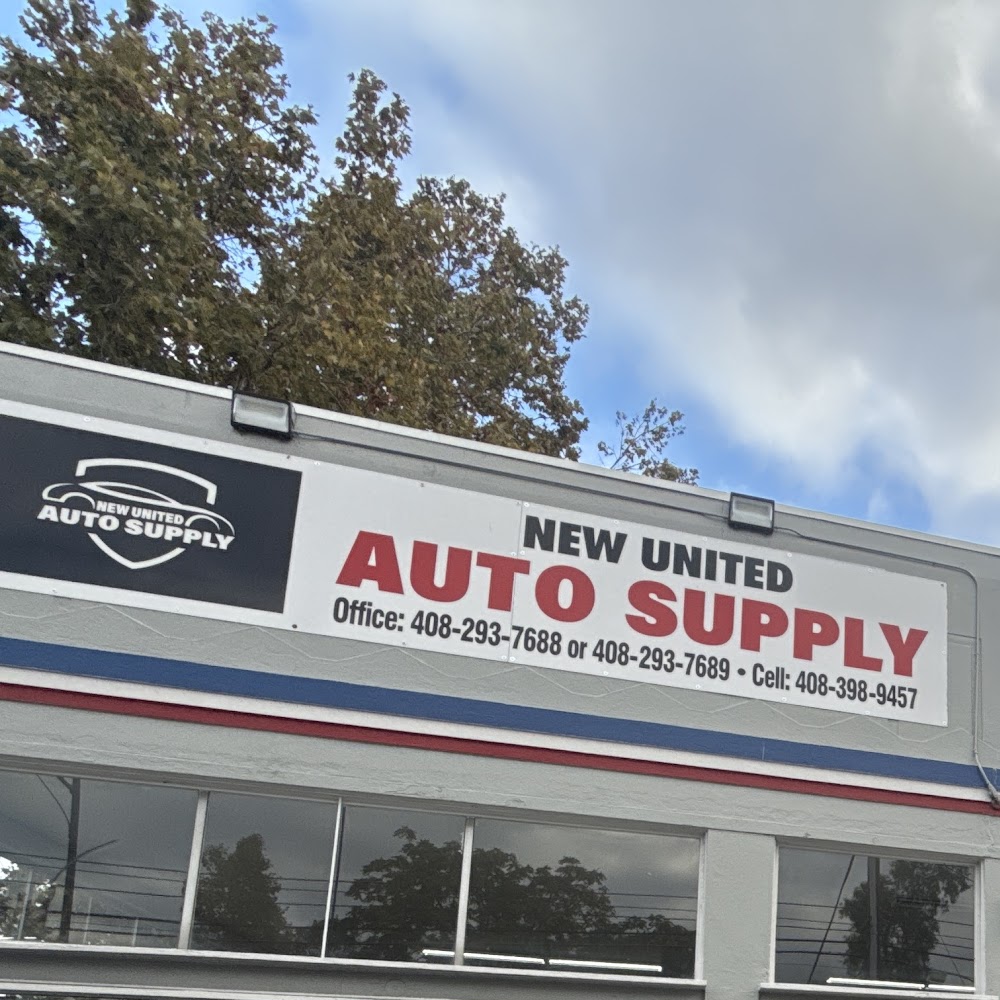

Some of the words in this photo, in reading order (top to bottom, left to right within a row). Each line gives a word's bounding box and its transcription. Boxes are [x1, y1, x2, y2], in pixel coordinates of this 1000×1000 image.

[36, 504, 120, 532] AUTO
[124, 519, 236, 551] SUPPLY
[96, 500, 130, 516] NEW
[131, 506, 185, 526] UNITED
[522, 515, 628, 564] NEW
[640, 537, 795, 593] UNITED
[335, 530, 596, 623] AUTO
[625, 579, 929, 678] SUPPLY
[332, 596, 405, 633] Office:
[410, 609, 563, 657] 408-293-7688
[567, 638, 589, 661] or
[592, 639, 732, 683] 408-293-7689
[751, 662, 791, 693] Cell:
[794, 669, 919, 712] 408-398-9457
